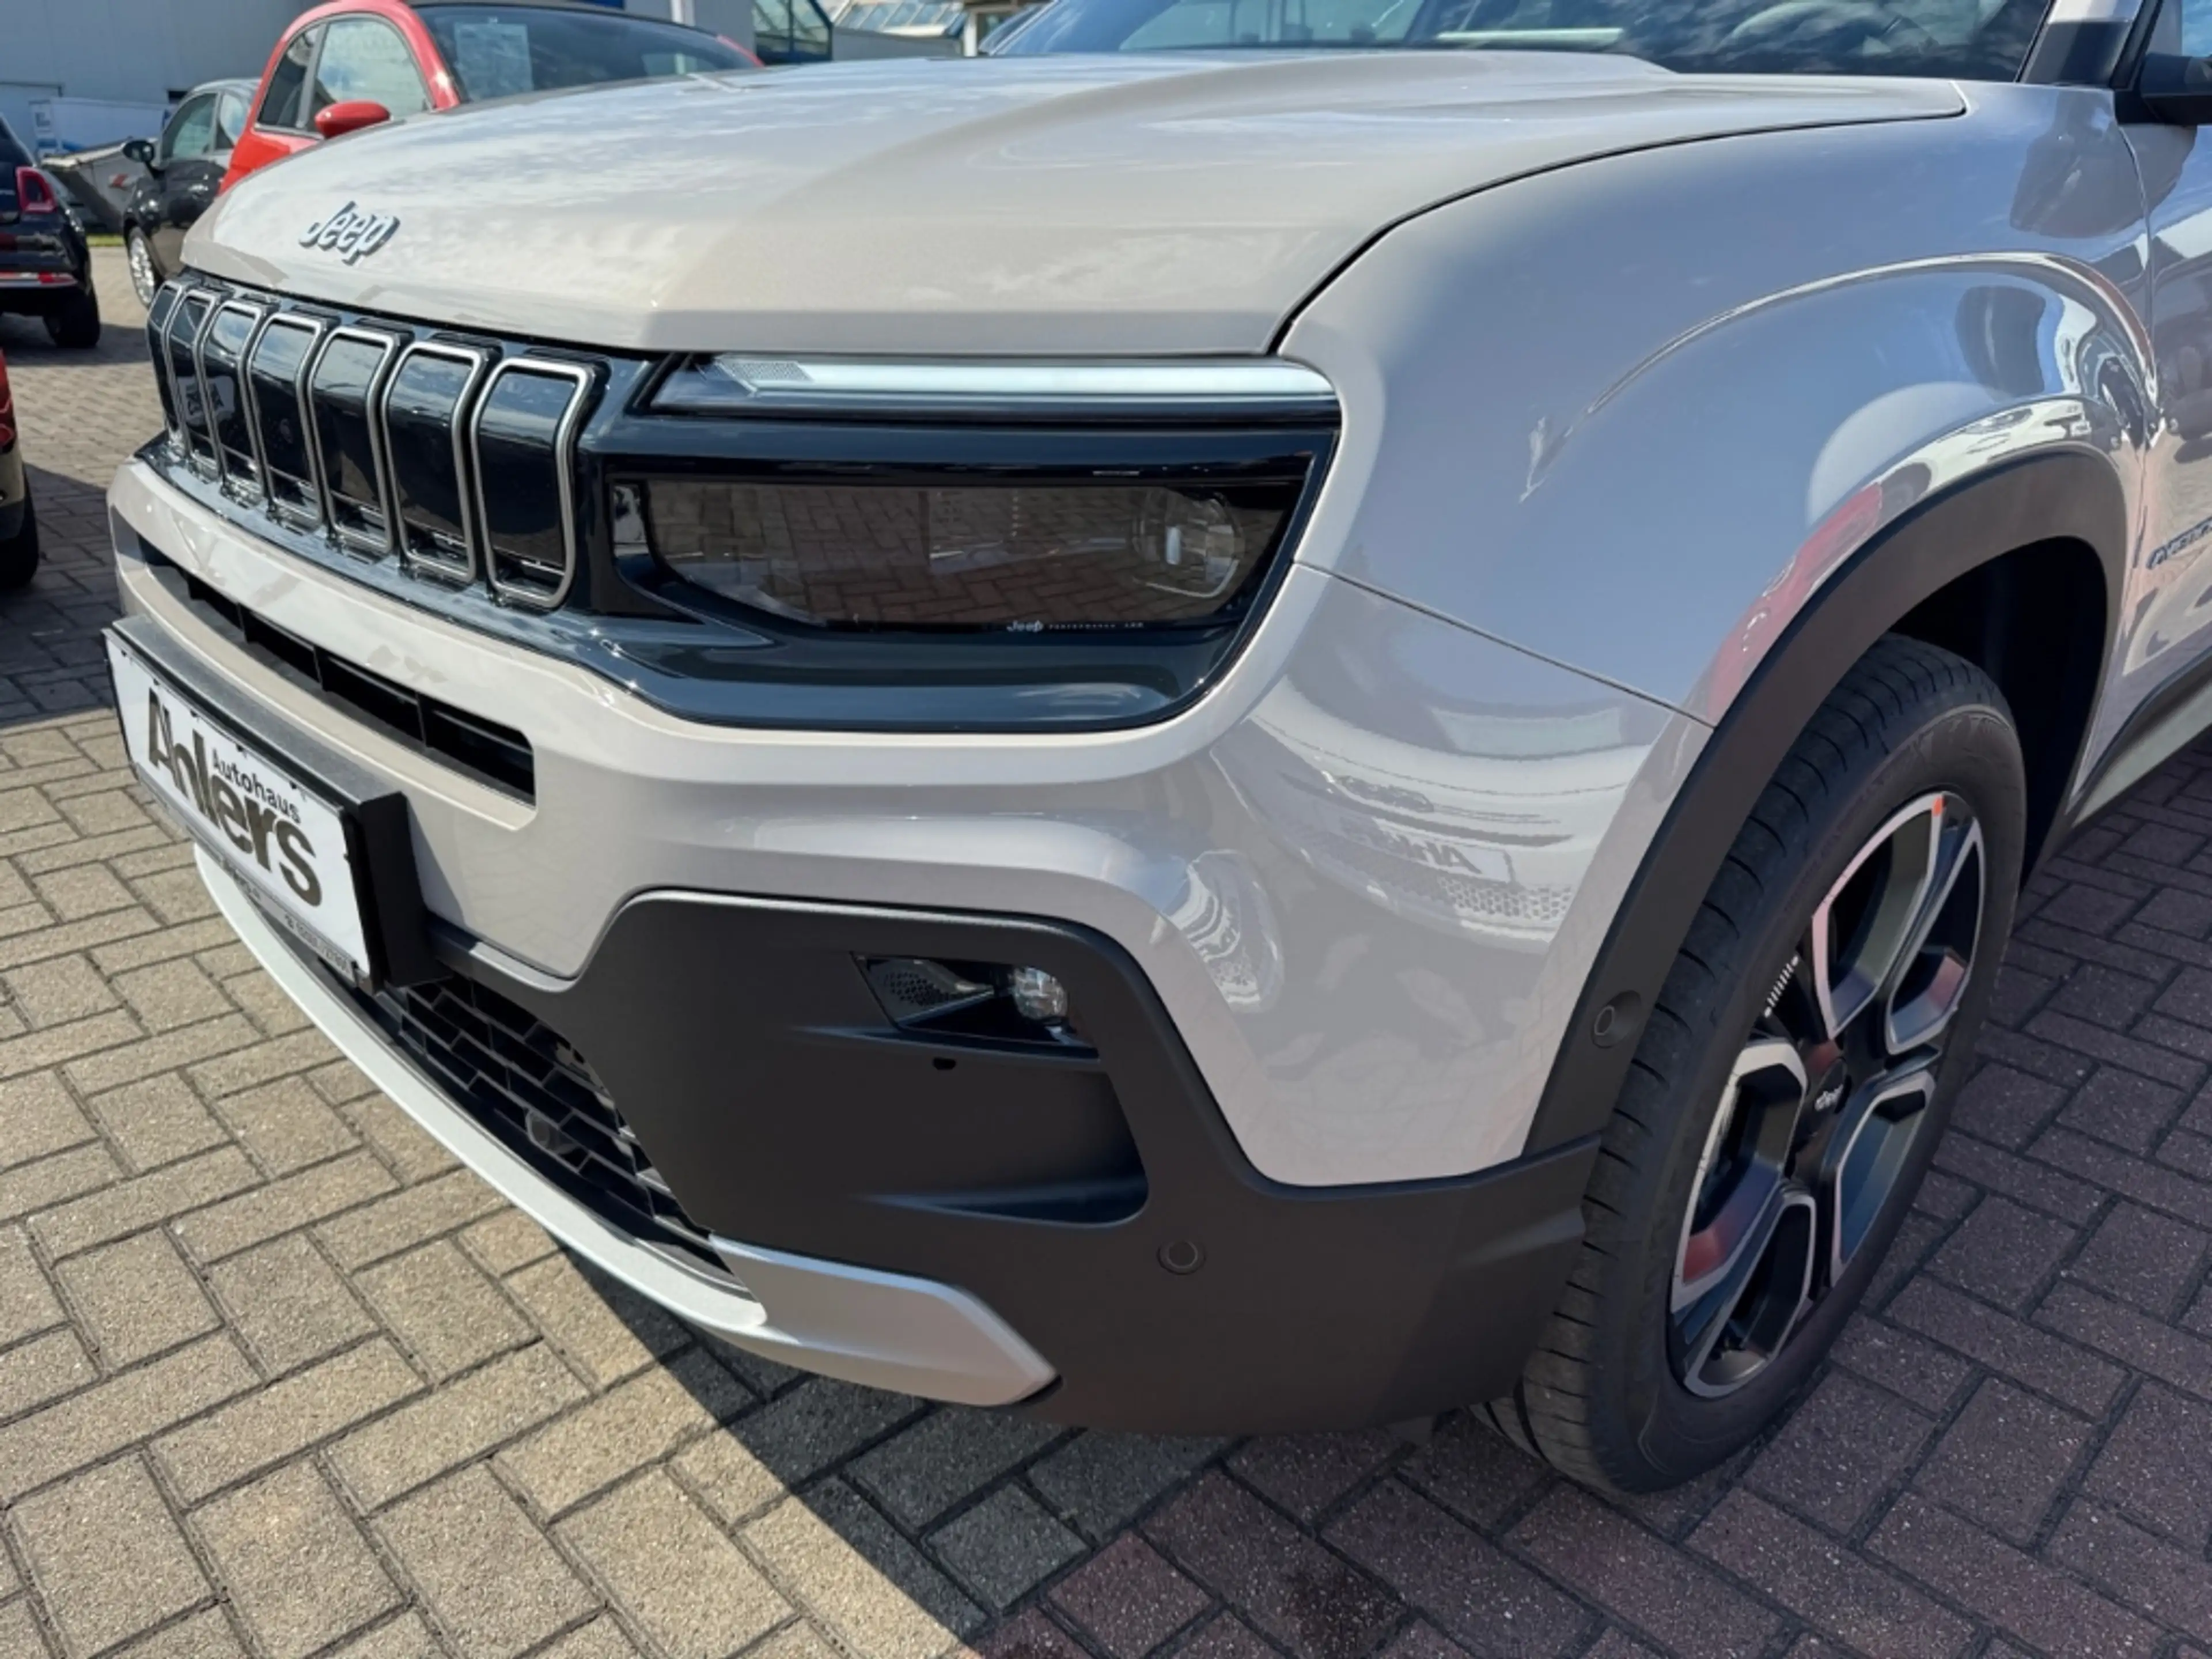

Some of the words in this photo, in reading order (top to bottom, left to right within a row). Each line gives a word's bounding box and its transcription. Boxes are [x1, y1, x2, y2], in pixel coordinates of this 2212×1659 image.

[298, 200, 400, 266] Jeep
[1006, 619, 1044, 632] Jeep
[149, 687, 322, 907] Ahlers
[213, 749, 301, 824] Autohaus
